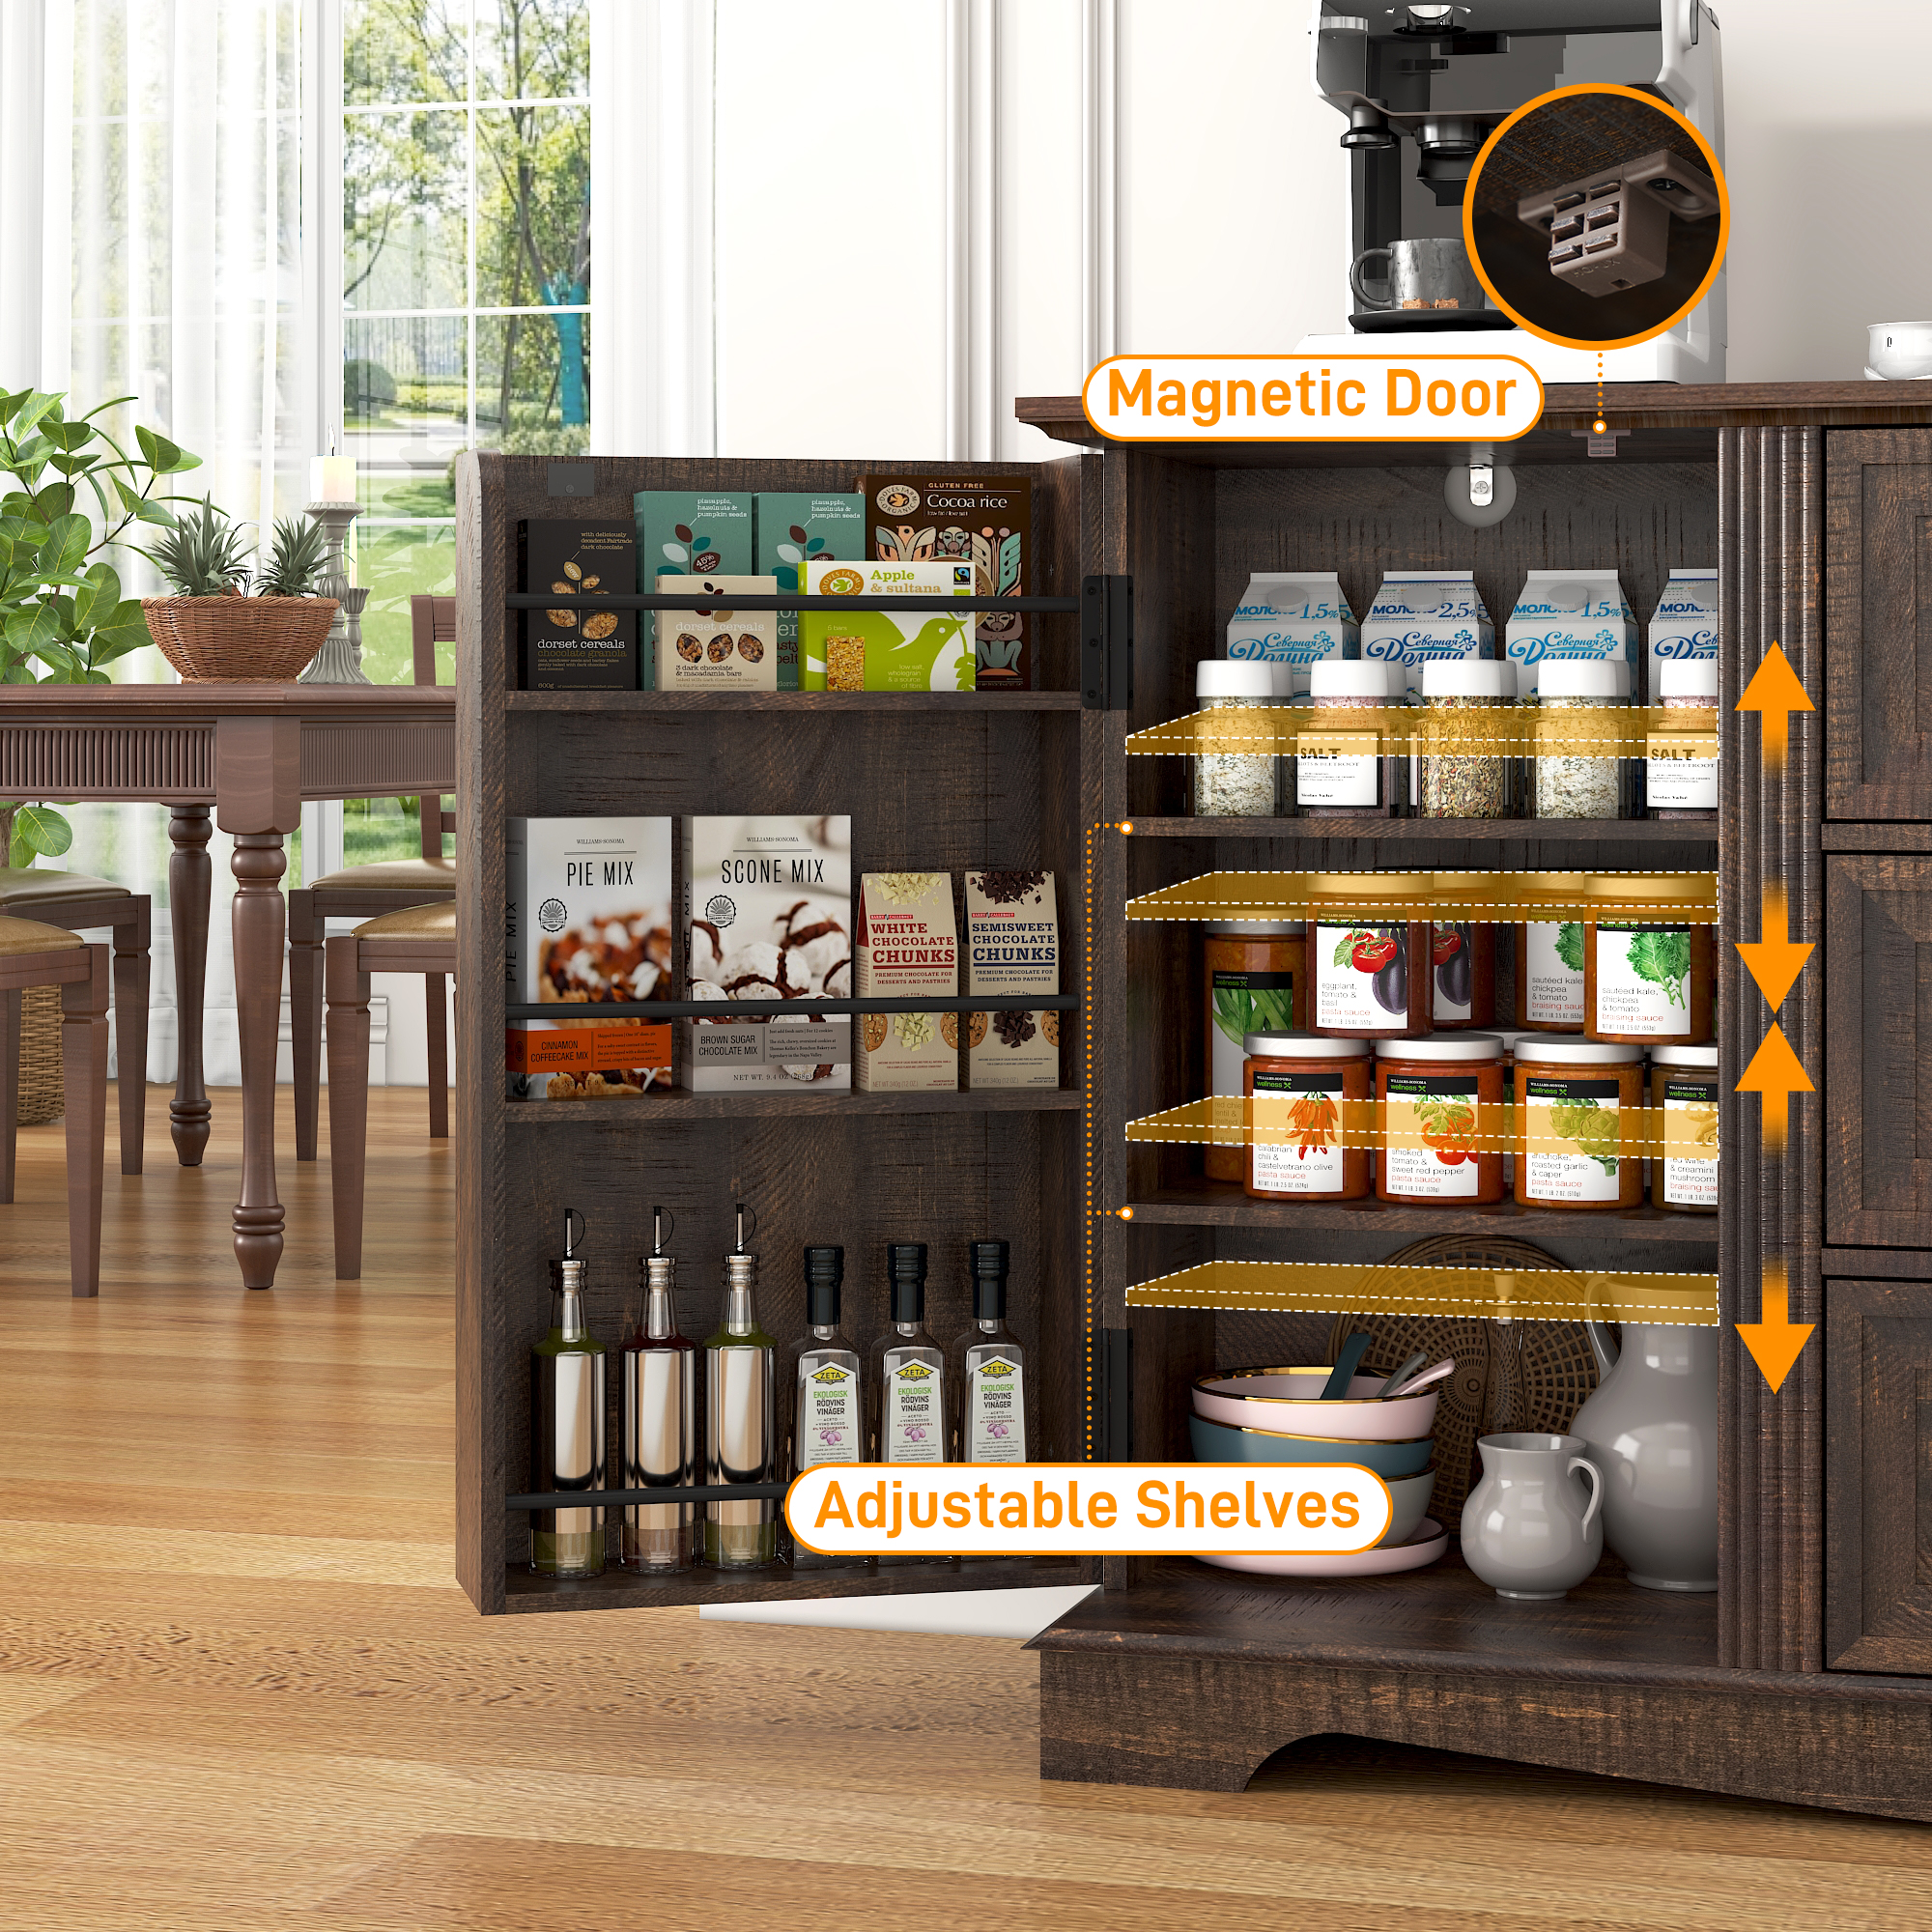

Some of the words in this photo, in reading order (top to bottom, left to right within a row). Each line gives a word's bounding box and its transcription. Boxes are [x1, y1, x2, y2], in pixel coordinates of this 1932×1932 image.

[927, 494, 976, 508] Cocoa
[980, 495, 1009, 508] rice
[566, 564, 579, 578] new
[870, 570, 914, 582] Apple
[822, 571, 839, 590] DOVES
[870, 583, 883, 593] &
[886, 583, 941, 593] sultana
[676, 622, 716, 632] dorset
[720, 622, 765, 632] cereals
[537, 639, 578, 649] dorset
[580, 639, 625, 649] cereals
[1264, 632, 1318, 649] Северная
[1403, 632, 1458, 649] Северная
[1544, 631, 1599, 649] Северная
[587, 649, 627, 658] granola
[1300, 748, 1341, 759] SALT
[1652, 749, 1696, 760] SALT
[567, 862, 593, 886] PIE
[604, 862, 634, 886] MIX
[722, 859, 782, 884] SCONE
[791, 859, 824, 883] MIX
[505, 901, 517, 937] MIX
[870, 923, 927, 933] WHITE
[972, 923, 1054, 932] SEMISWEET
[872, 937, 954, 946] CHOCOLATE
[973, 935, 1055, 944] CHOCOLATE
[873, 949, 954, 963] CHUNKS
[973, 948, 1055, 960] CHUNKS
[1532, 1002, 1562, 1010] braising
[1602, 1013, 1634, 1022] braising
[700, 1036, 728, 1044] BROWN
[541, 1040, 578, 1051] CINNAMON
[698, 1047, 742, 1056] CHOCOLATE
[744, 1046, 757, 1055] MIX
[531, 1052, 574, 1062] COFFEECAKE
[577, 1051, 588, 1060] MIX
[1258, 1162, 1311, 1171] castelvetrano
[1678, 1165, 1714, 1174] creamini
[1539, 1170, 1562, 1179] caper
[1670, 1174, 1716, 1182] mushroom
[1670, 1182, 1702, 1192] braising
[900, 1395, 929, 1404] RÖDVINS
[817, 1406, 844, 1415] VINÄGER
[900, 1404, 929, 1412] VINÄGER
